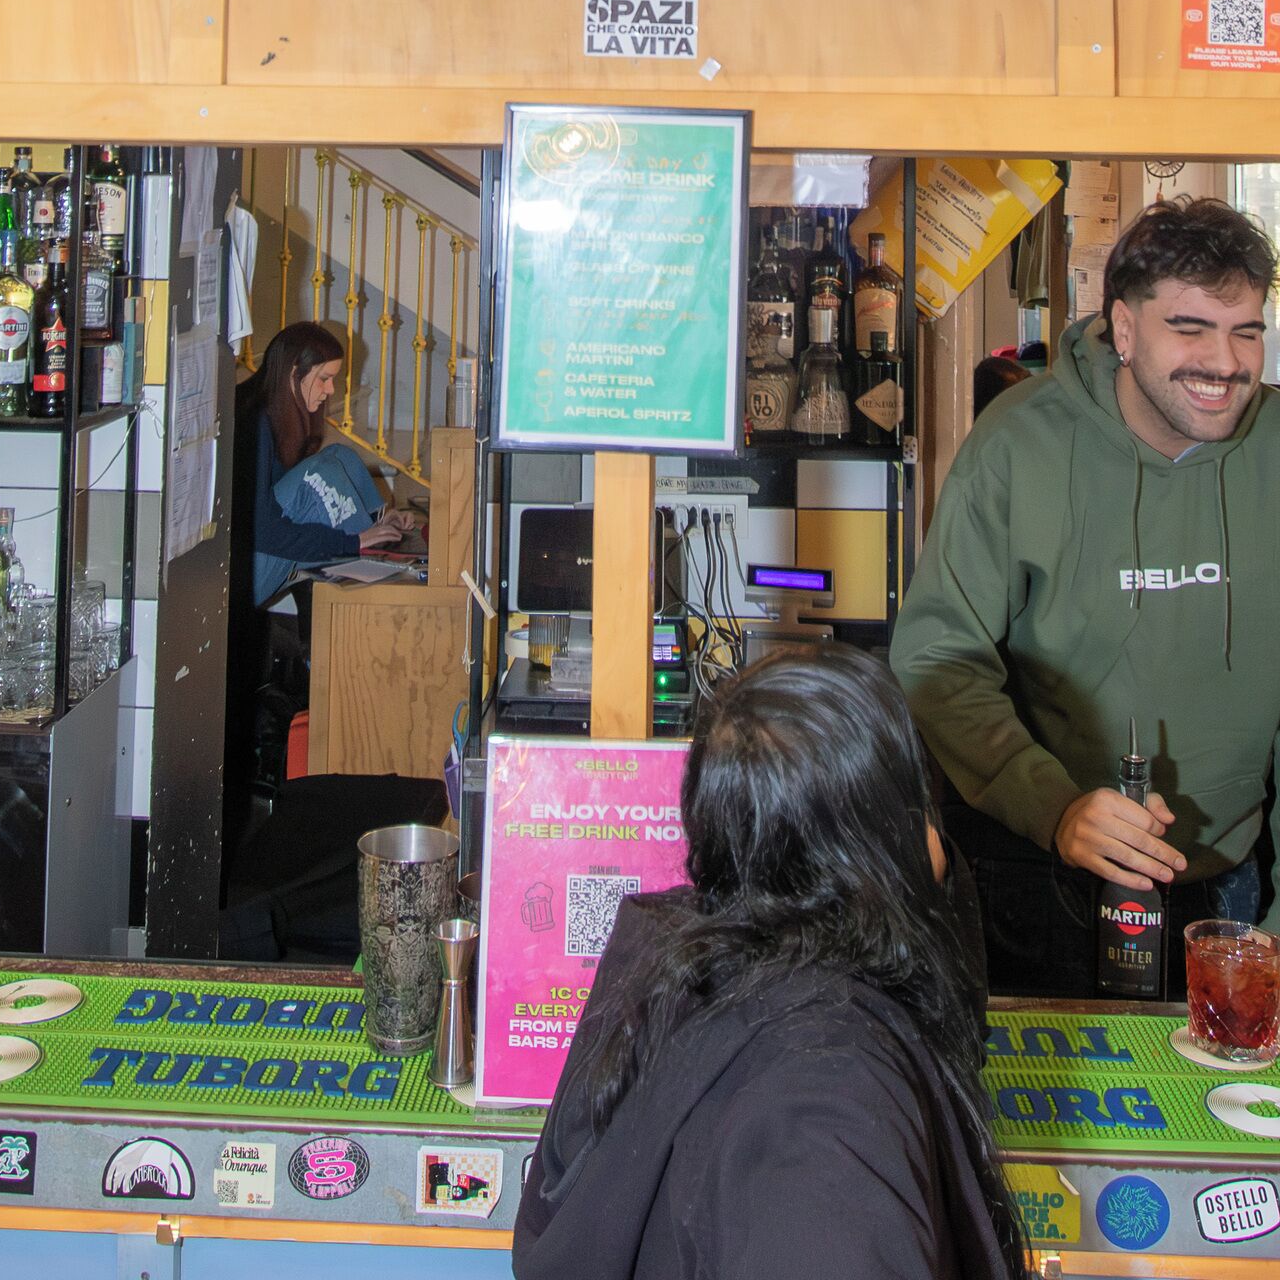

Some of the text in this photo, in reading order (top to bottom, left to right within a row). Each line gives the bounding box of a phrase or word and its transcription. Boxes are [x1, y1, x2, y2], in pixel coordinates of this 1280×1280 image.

[588, 0, 693, 24] SPAZI
[587, 24, 694, 35] CHE CAMBIANO
[587, 35, 693, 55] LA VITA
[649, 172, 715, 188] DRINK
[615, 298, 676, 311] DRINKS
[566, 342, 665, 356] AMERICANO
[566, 355, 634, 366] MARTINI
[564, 373, 655, 387] CAFETERIA
[580, 387, 636, 400] WATER
[564, 406, 692, 421] APEROL SPRITZ
[1120, 562, 1221, 591] BELLO
[530, 804, 682, 821] ENJOY YOUR
[505, 824, 562, 839] FREE
[568, 824, 640, 840] DRINK
[1101, 904, 1162, 926] MARTINI
[1108, 947, 1152, 965] BITTER
[114, 988, 366, 1032] UBORG
[514, 1003, 581, 1017] EVERY
[509, 1020, 562, 1033] FROM
[509, 1034, 558, 1048] BARS
[80, 1047, 403, 1101] TUBORG
[231, 1146, 260, 1159] Felicità
[1205, 1186, 1268, 1214] OSTELLO
[1219, 1209, 1263, 1234] BELLO
